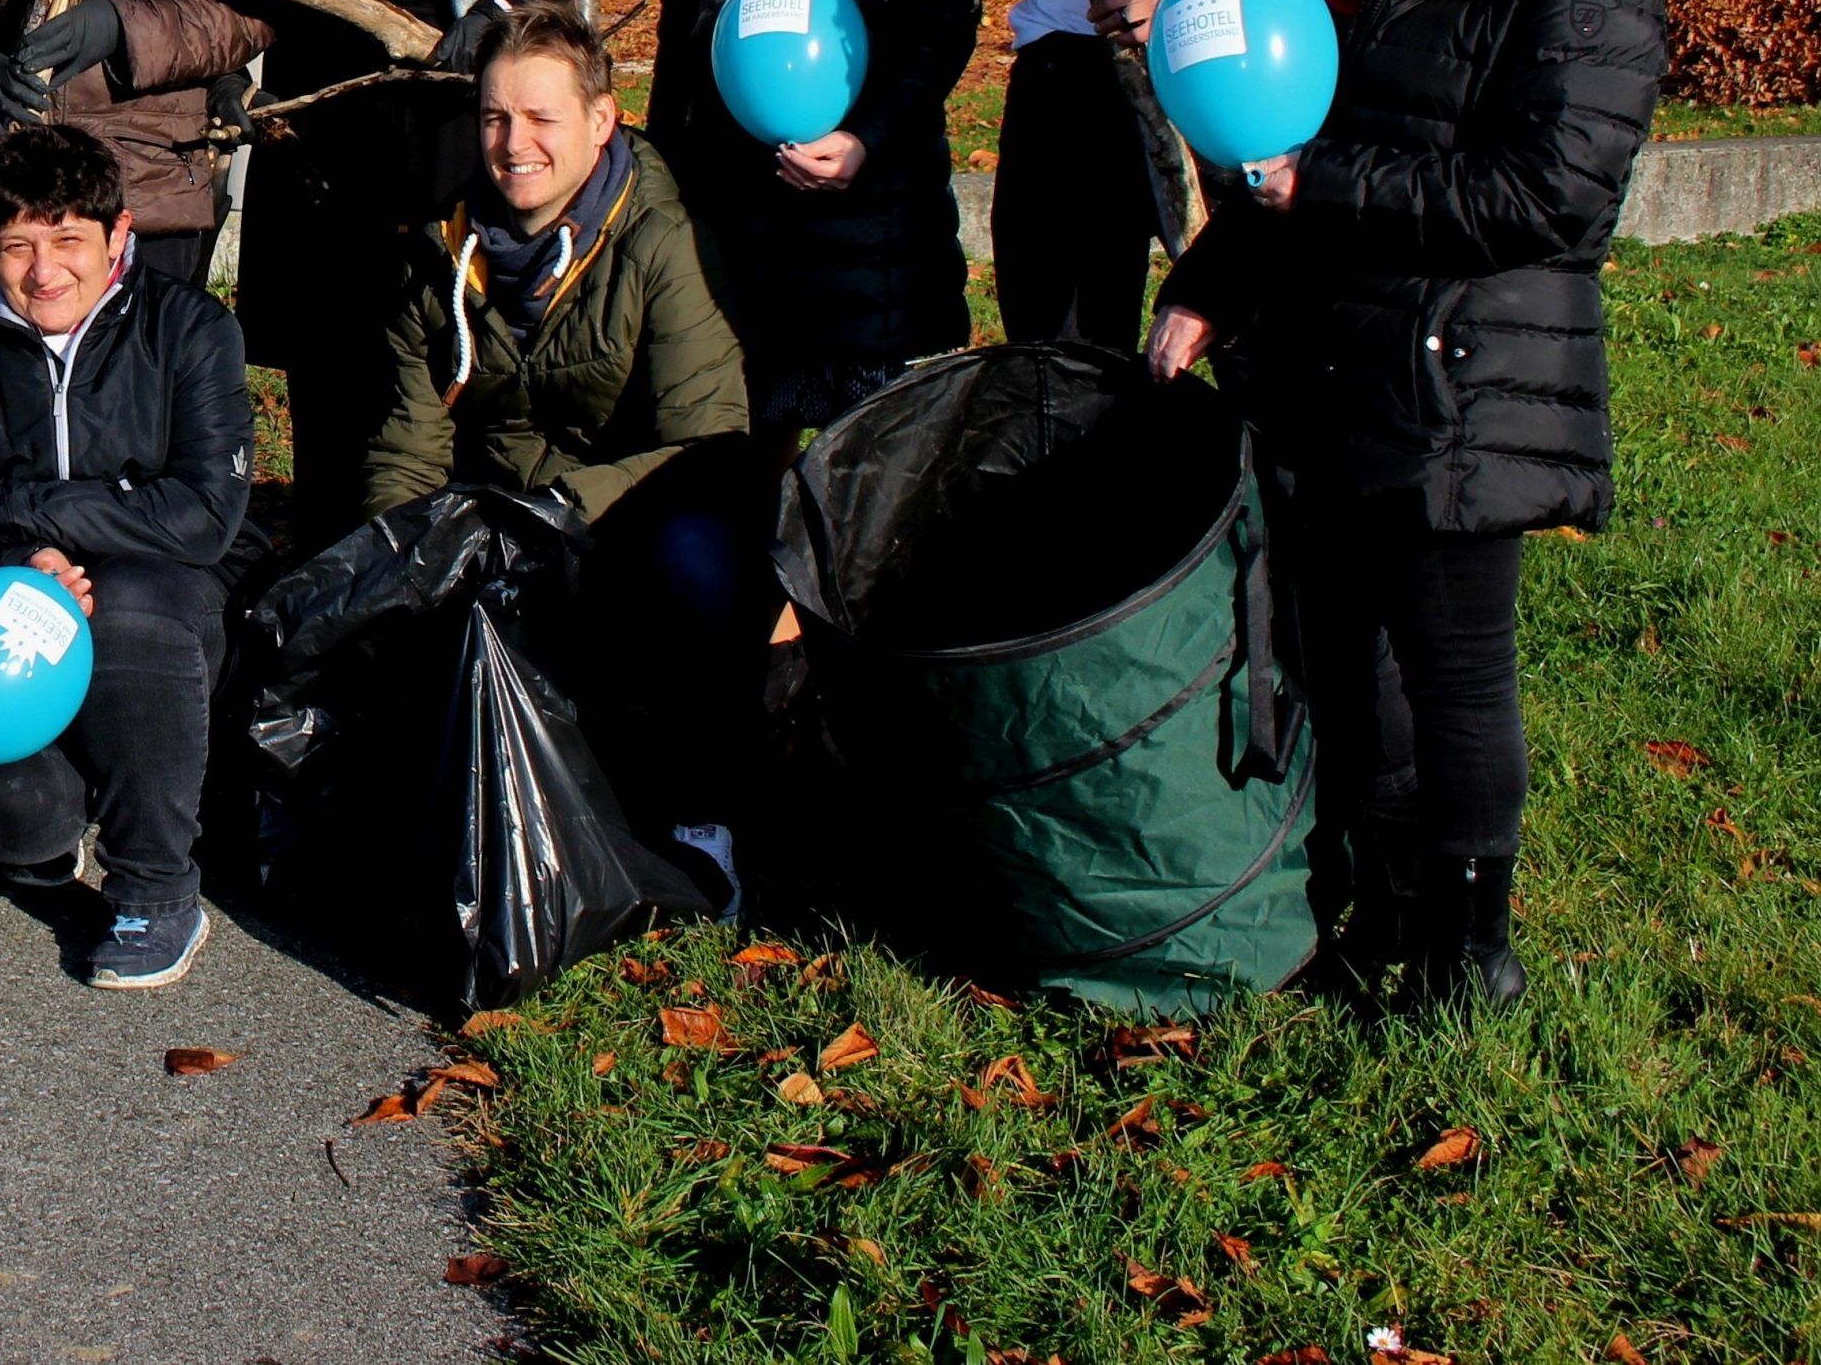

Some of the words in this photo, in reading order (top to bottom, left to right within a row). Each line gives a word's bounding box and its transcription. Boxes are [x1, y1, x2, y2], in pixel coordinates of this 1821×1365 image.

[1165, 10, 1236, 43] SEEHOTEL
[1178, 27, 1239, 49] KAISERSTRAND
[6, 597, 68, 648] SEEHOTEL
